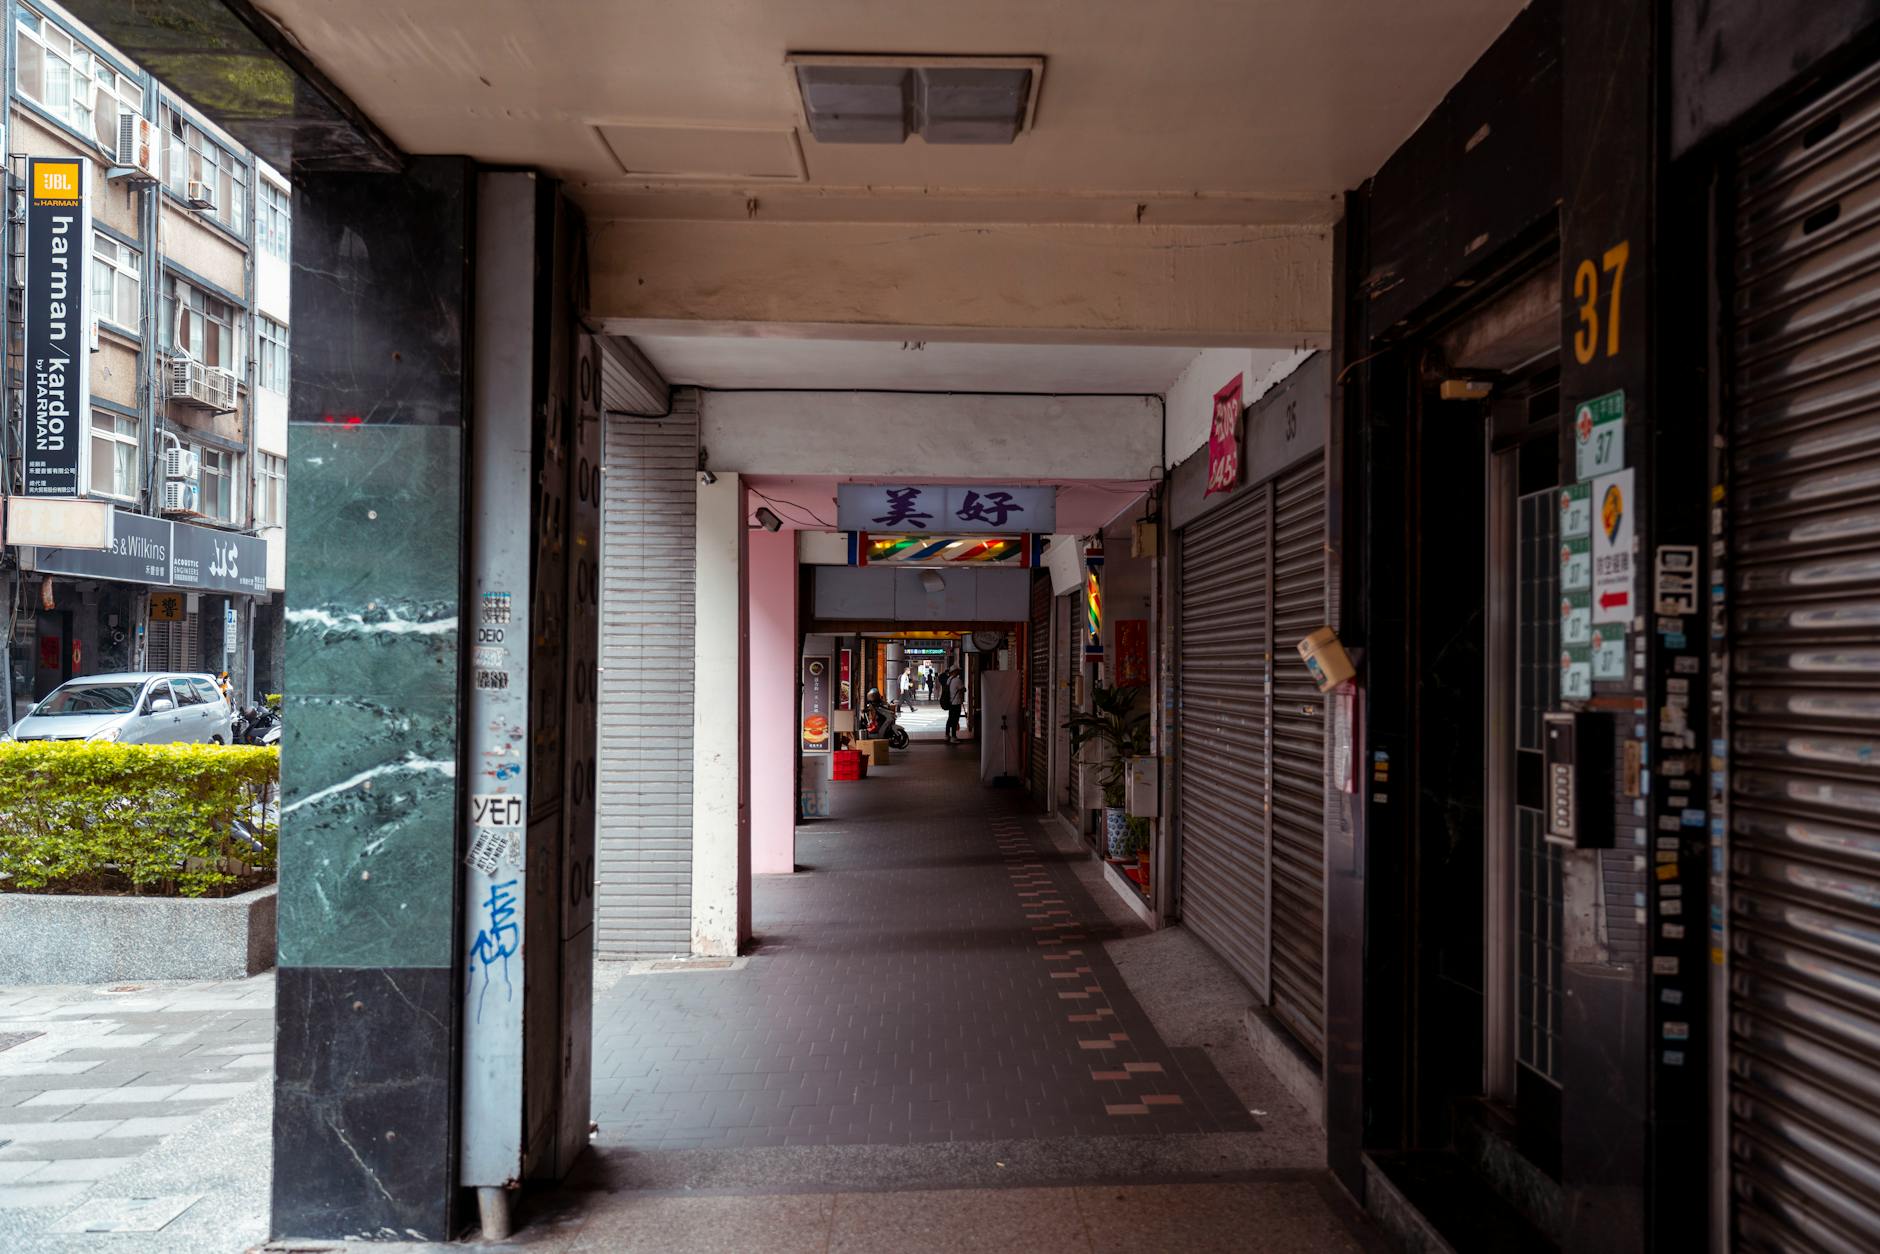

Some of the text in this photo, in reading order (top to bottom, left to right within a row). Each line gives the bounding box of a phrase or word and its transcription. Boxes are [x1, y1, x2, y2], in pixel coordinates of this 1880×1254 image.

[43, 174, 72, 190] JBL
[1574, 240, 1630, 366] 37
[36, 375, 48, 451] HARMAN
[1595, 429, 1613, 466] 37
[872, 487, 1025, 528] 美好
[174, 558, 199, 568] ACOUSTIC
[466, 829, 491, 865] OPTIMIST
[476, 833, 501, 869] ATLANTIC
[485, 838, 509, 873] ISLANDER
